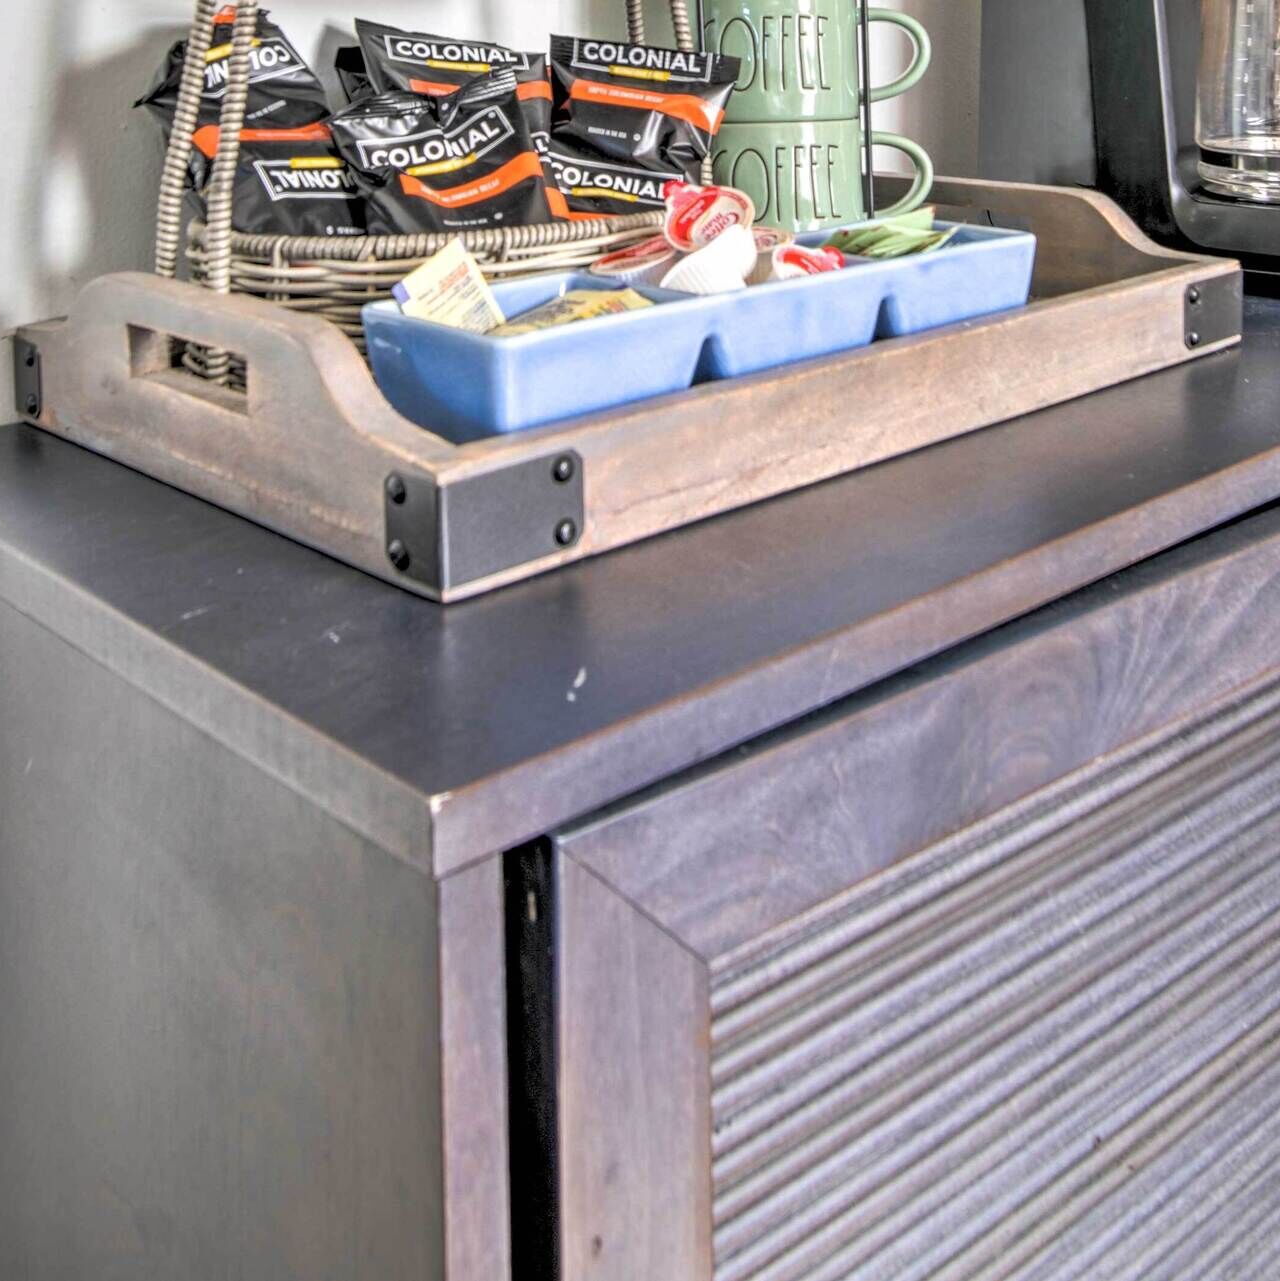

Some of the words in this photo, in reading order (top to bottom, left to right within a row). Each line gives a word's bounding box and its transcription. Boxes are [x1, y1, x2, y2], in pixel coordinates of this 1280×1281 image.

[395, 40, 518, 63] COLONIAL
[582, 42, 701, 73] COLONIAL
[704, 14, 831, 93] OFFEE
[370, 120, 501, 168] COLONIAL
